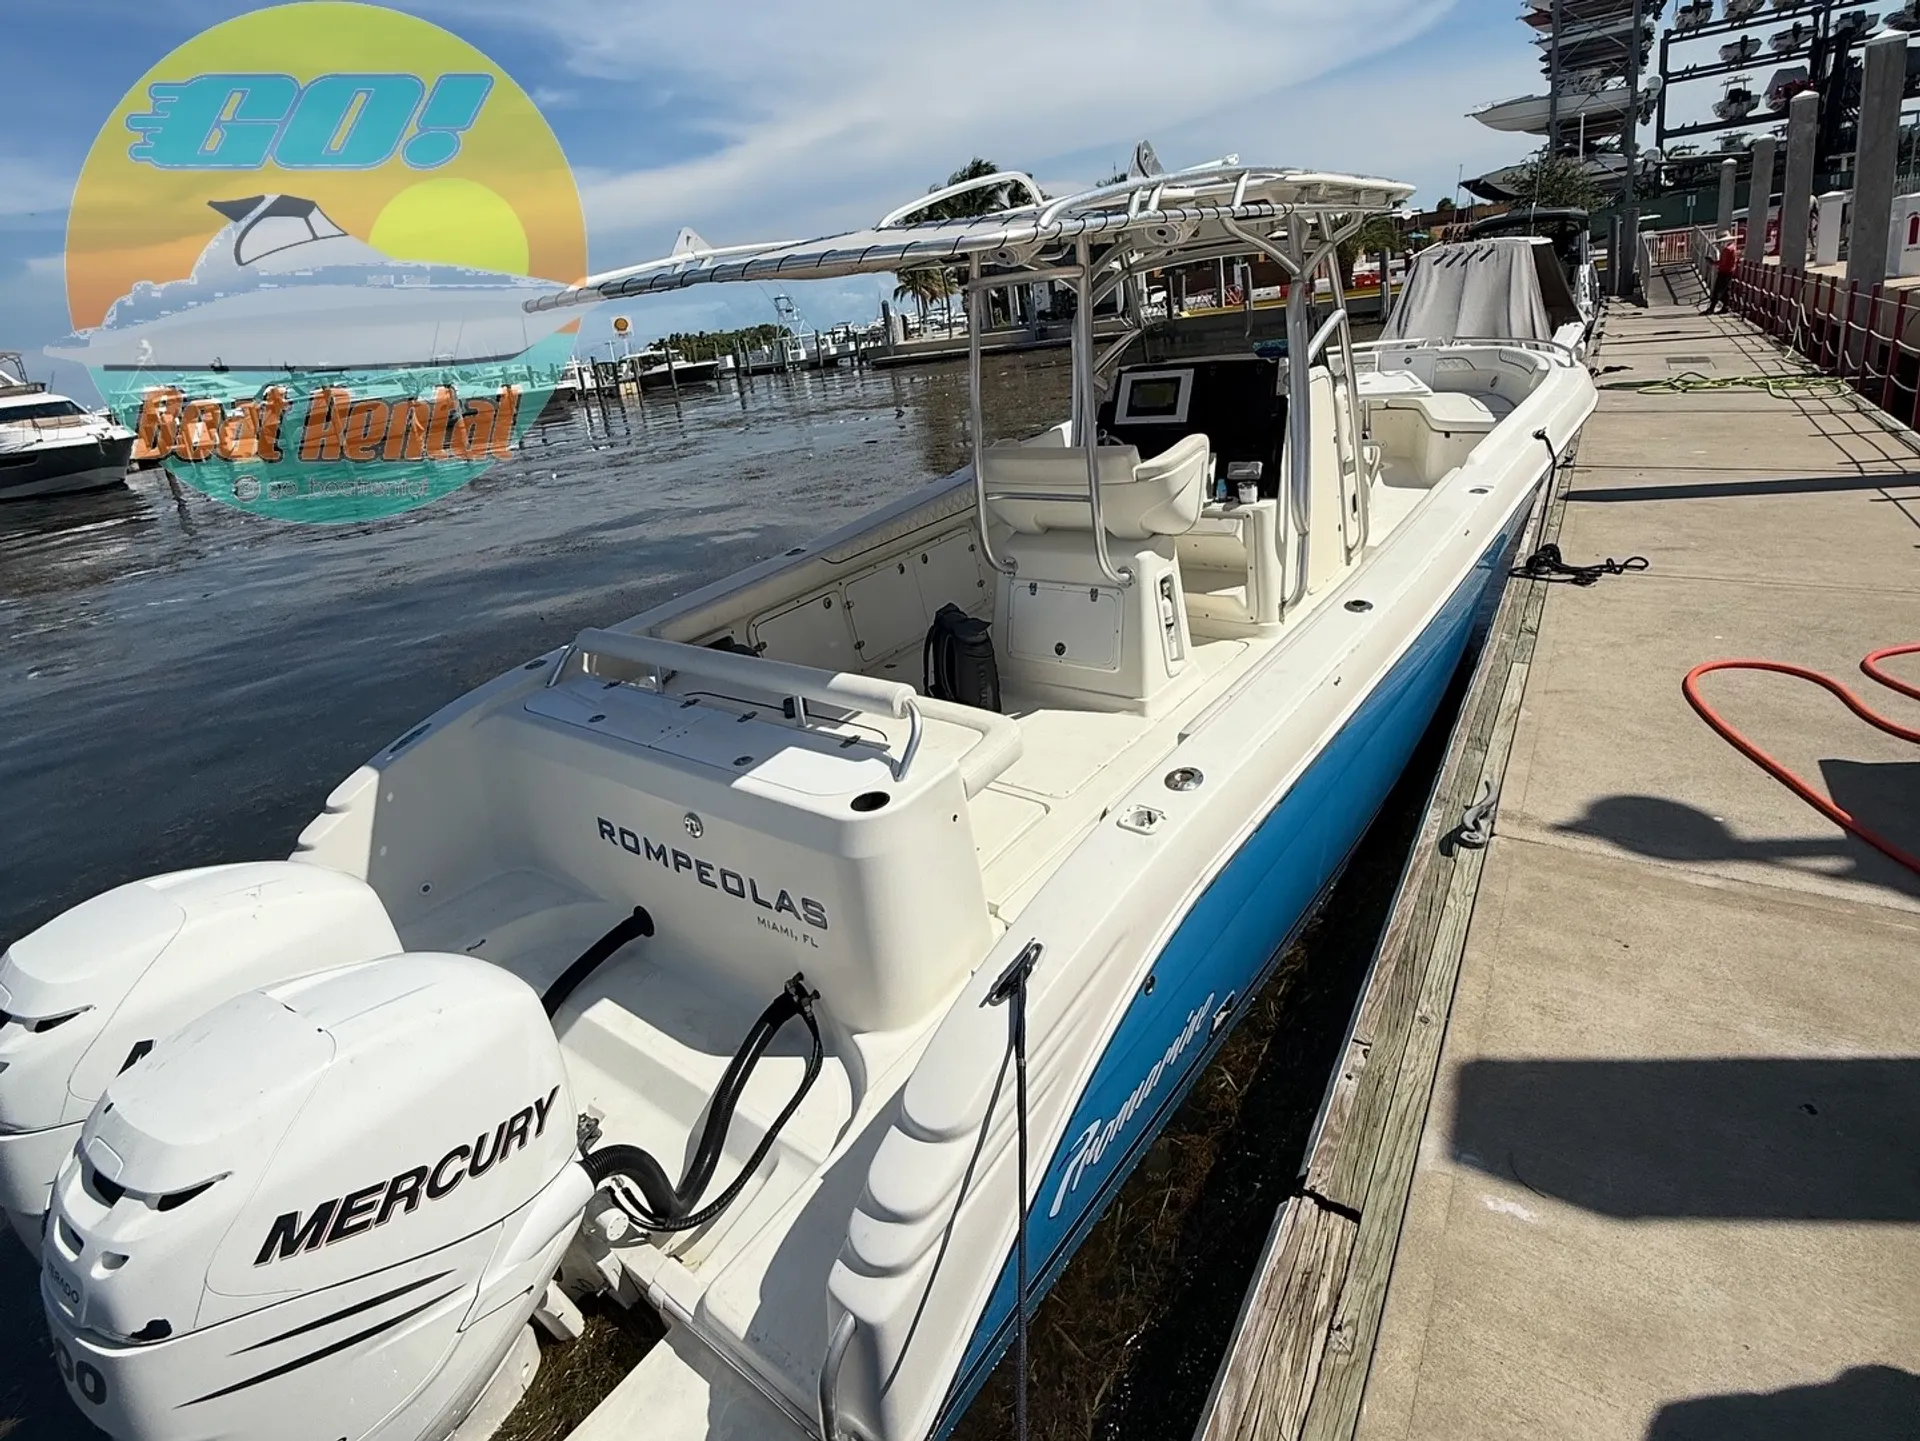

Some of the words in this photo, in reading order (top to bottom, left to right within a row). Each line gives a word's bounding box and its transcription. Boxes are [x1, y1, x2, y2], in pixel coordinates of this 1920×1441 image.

[597, 817, 829, 930] ROMPEOLAS
[757, 916, 799, 942] MIAMI,
[803, 934, 819, 948] FL
[253, 1084, 561, 1267] MERCURY
